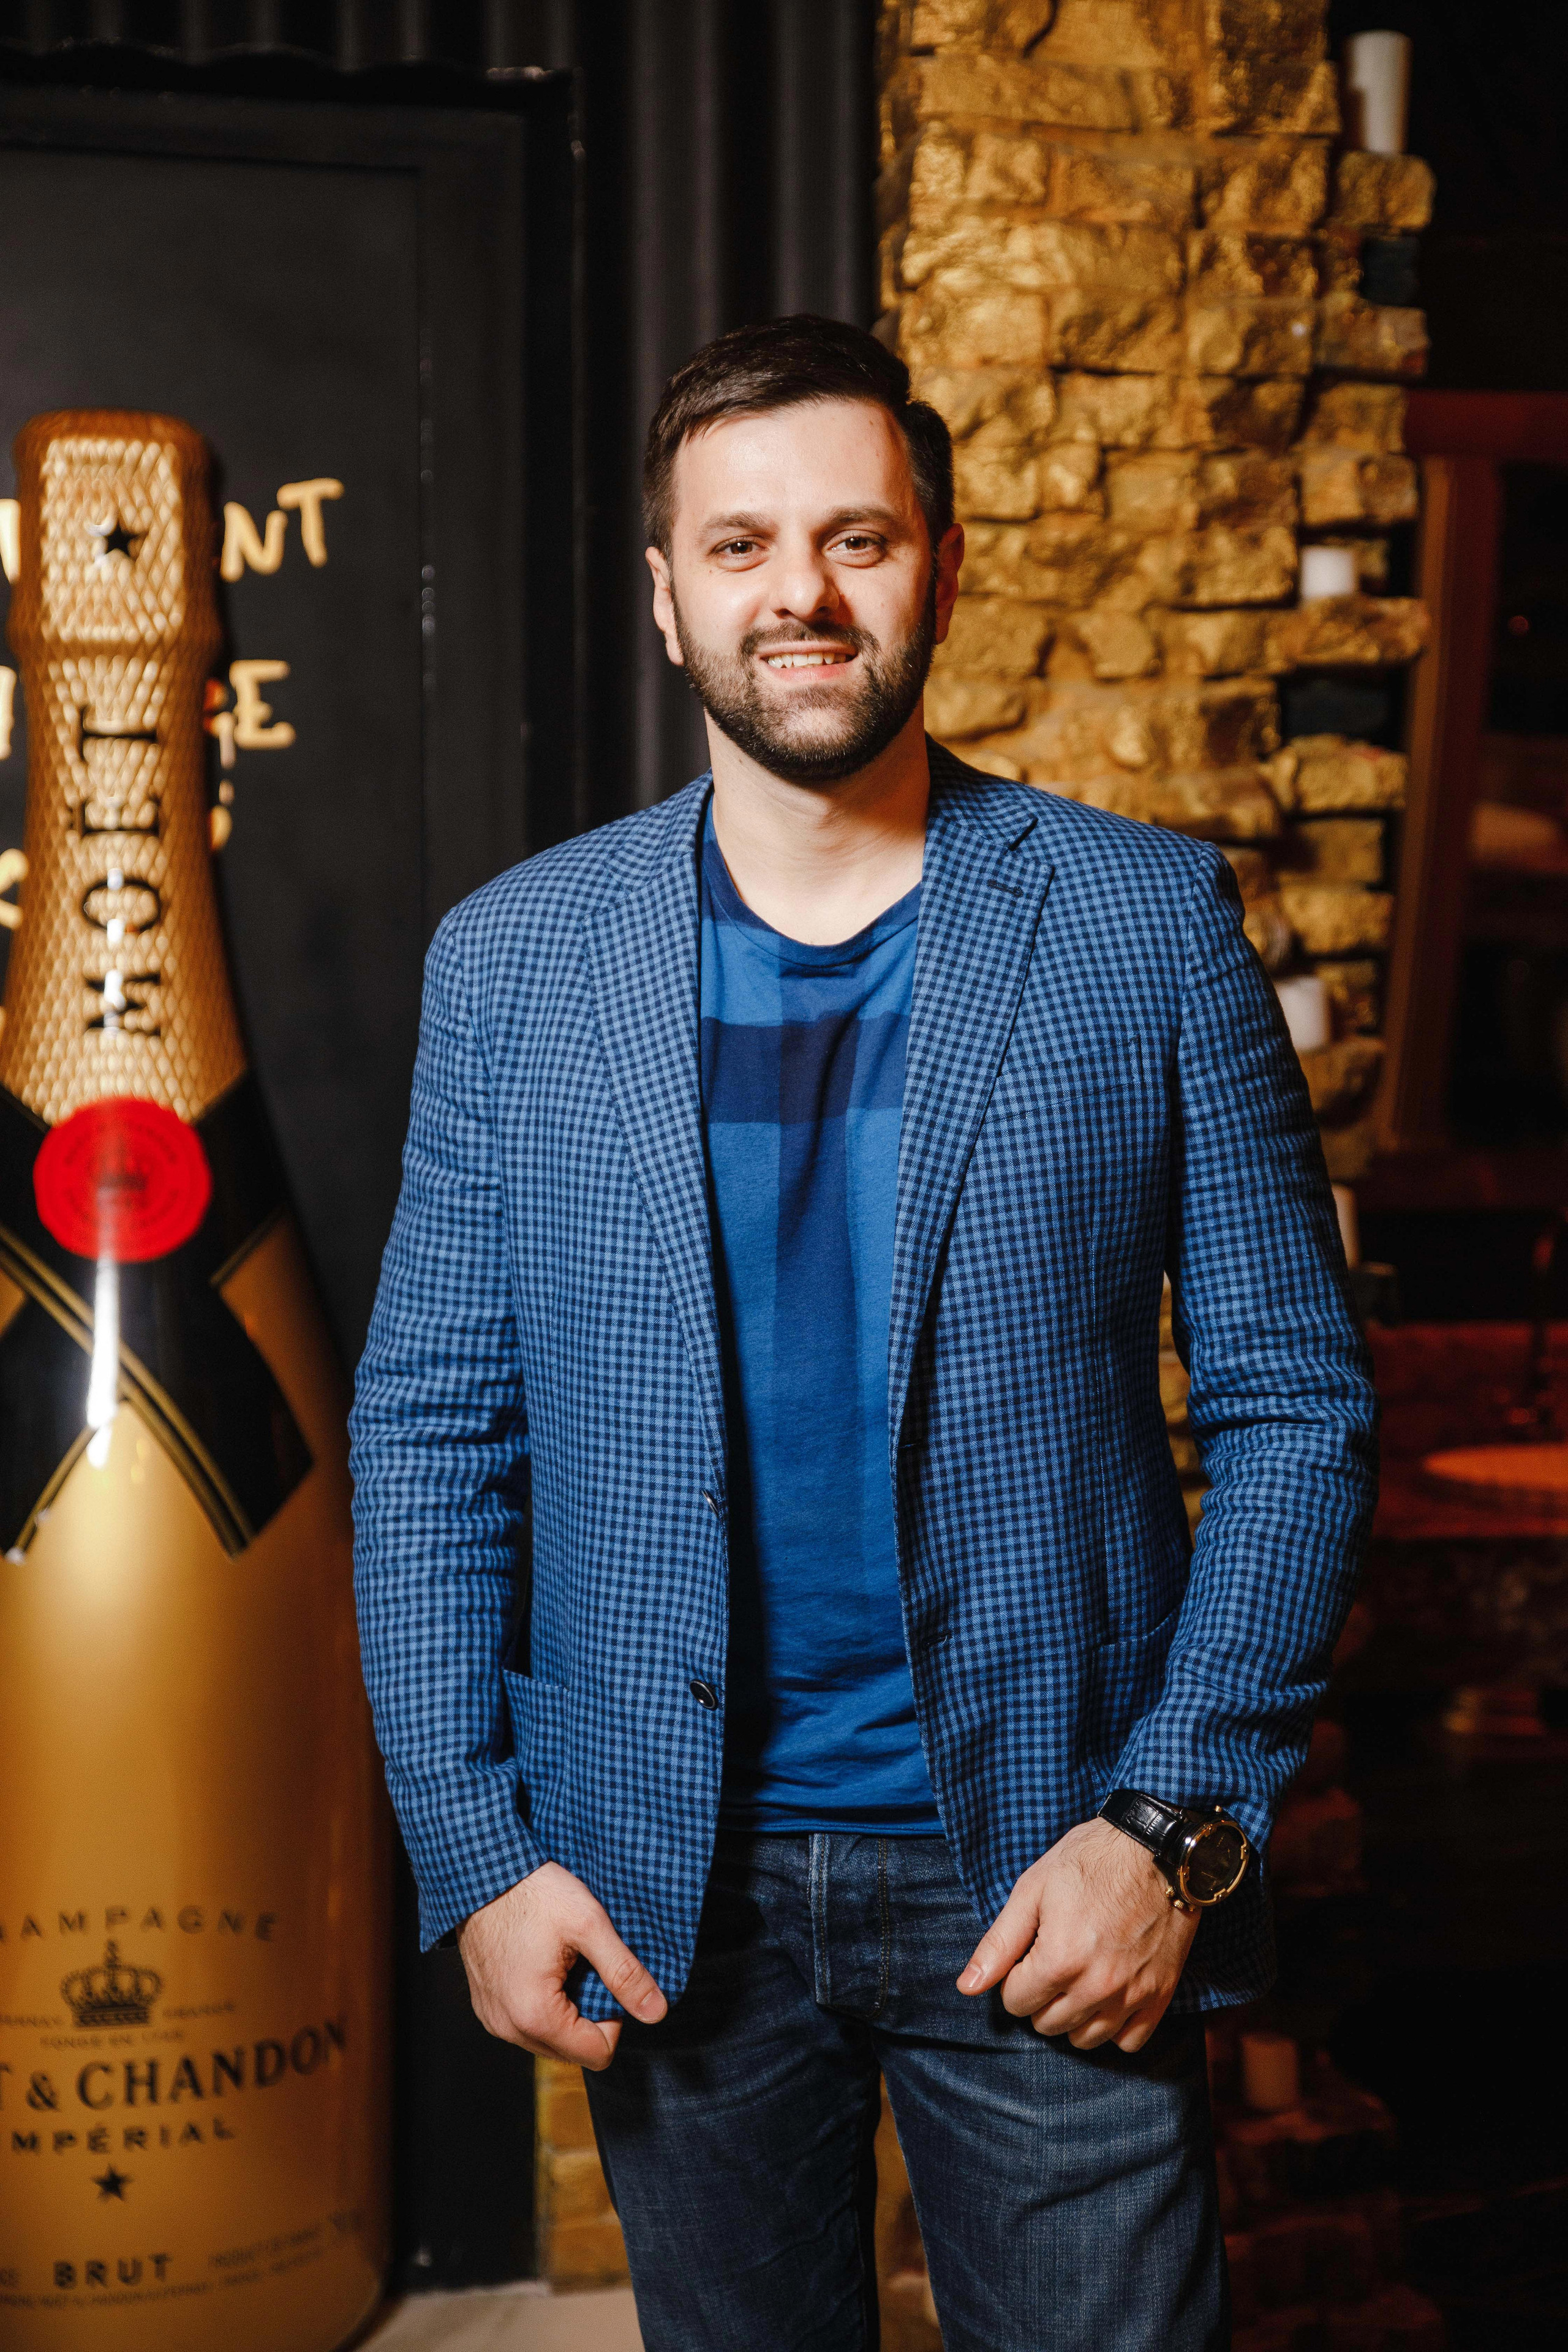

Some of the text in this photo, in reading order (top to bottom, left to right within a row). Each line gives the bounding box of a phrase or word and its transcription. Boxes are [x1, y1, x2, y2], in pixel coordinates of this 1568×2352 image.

[221, 477, 345, 582] NT
[0, 1905, 278, 1942] AMPAGNE
[24, 2070, 60, 2112] &
[75, 2010, 349, 2111] CHANDON
[11, 2115, 237, 2155] MPÉRIAL
[53, 2252, 173, 2290] BRUT
